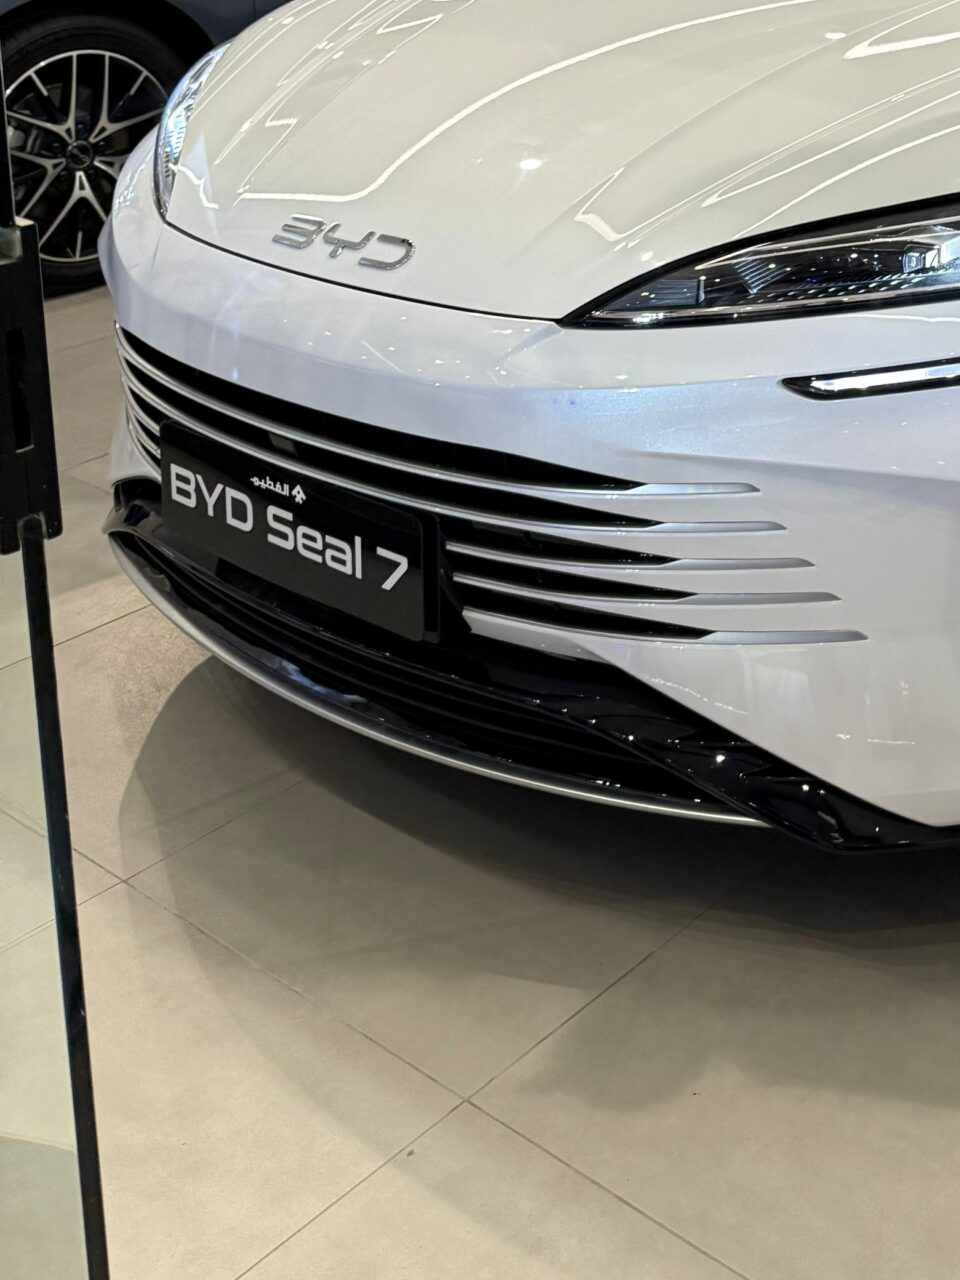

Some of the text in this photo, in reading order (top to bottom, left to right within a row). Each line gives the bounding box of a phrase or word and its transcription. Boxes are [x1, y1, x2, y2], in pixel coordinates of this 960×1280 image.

[271, 213, 416, 271] BYD
[250, 476, 289, 497] الفطيم
[170, 463, 409, 591] BYD Seal 7
